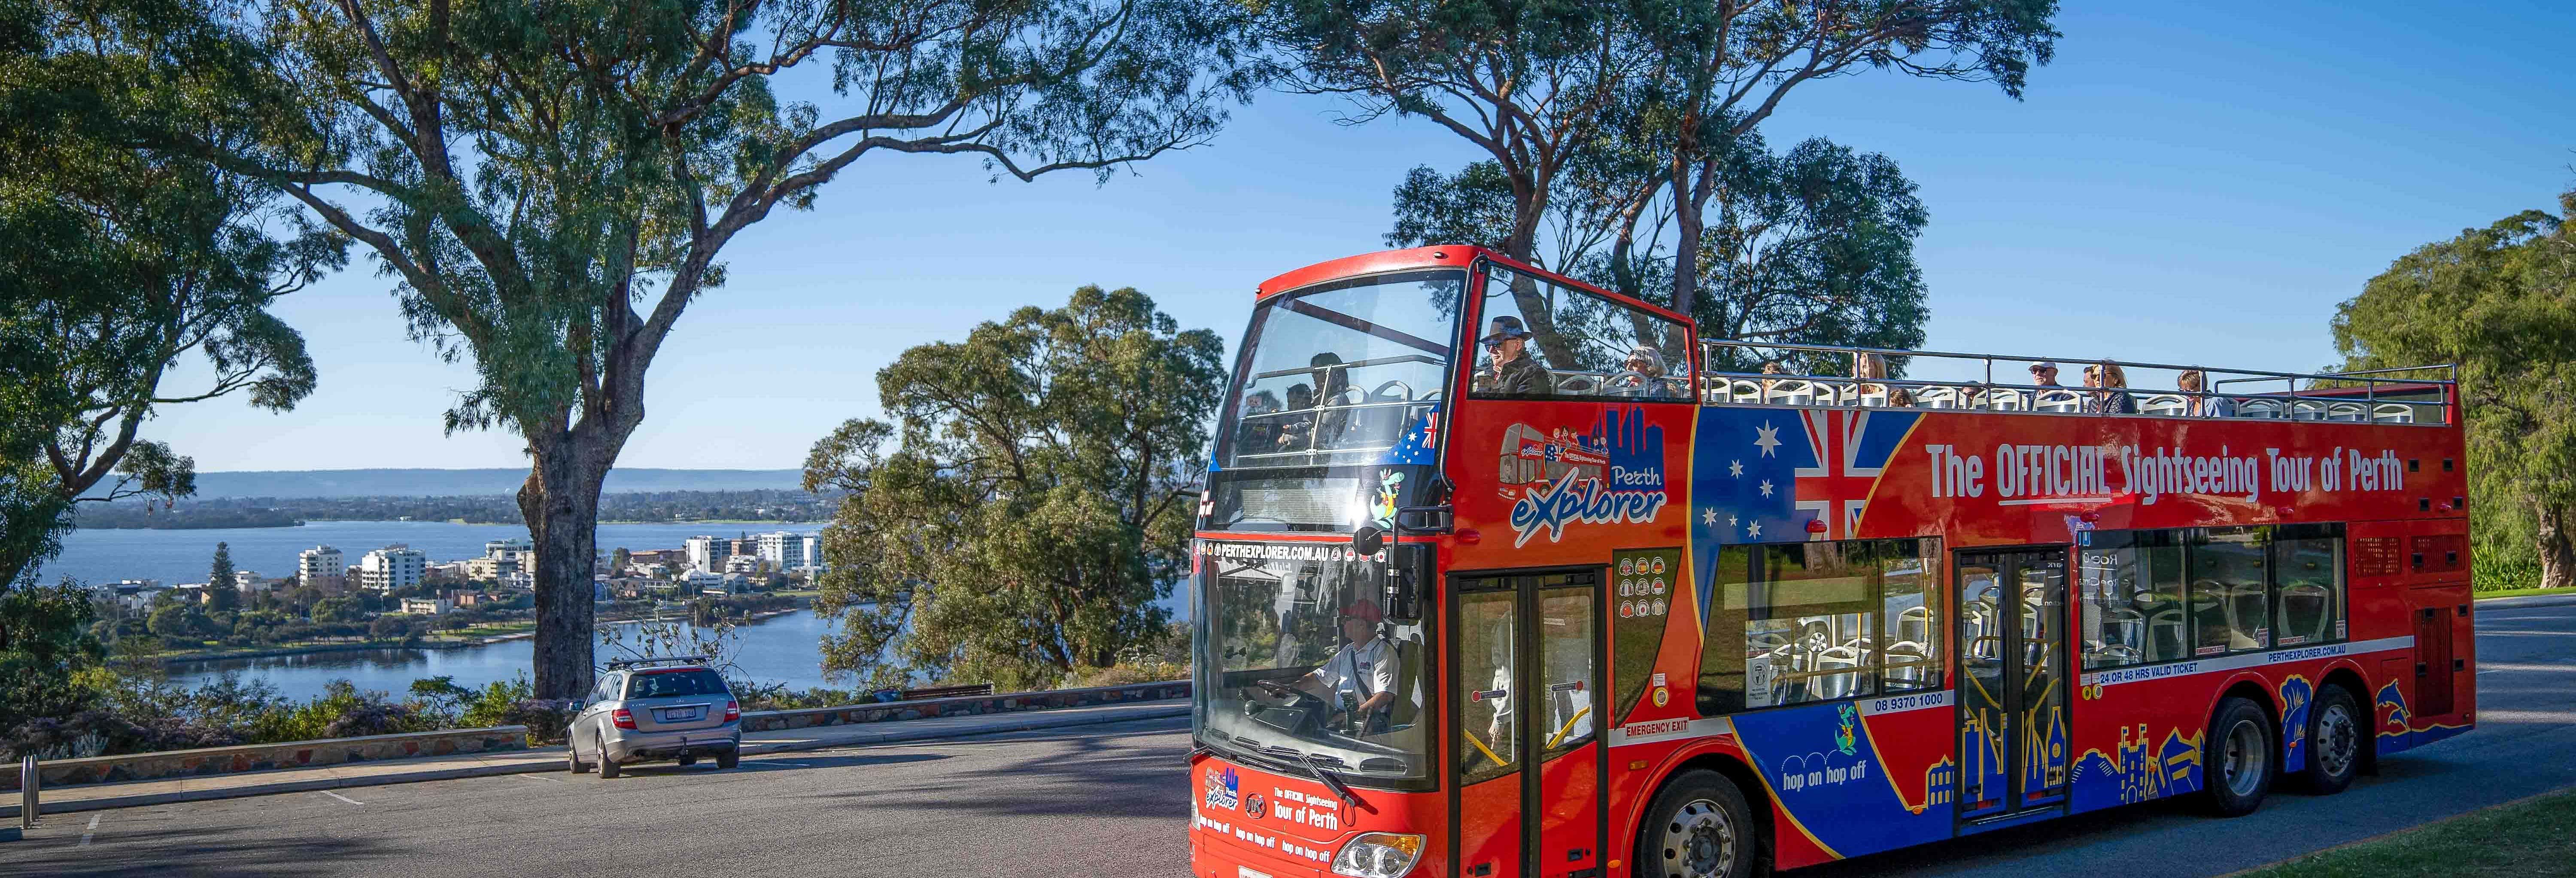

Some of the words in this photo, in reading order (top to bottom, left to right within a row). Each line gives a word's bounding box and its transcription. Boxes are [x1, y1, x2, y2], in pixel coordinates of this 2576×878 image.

[1611, 465, 1662, 486] Perth
[1926, 444, 1983, 498] The
[1996, 444, 2111, 497] OFFICIAL
[2121, 444, 2258, 505] Sightseeing
[2266, 447, 2313, 492] Tour
[2321, 447, 2341, 492] of
[2349, 447, 2403, 491] Perth
[1221, 544, 1329, 561] PERTHEXPLORER.COM.AU
[2269, 645, 2346, 662] PERTHEXPLORER.COM.AU
[2100, 674, 2109, 684] 24
[2111, 671, 2122, 682] OR
[2124, 670, 2133, 680] 48
[2135, 668, 2150, 679] HRS
[2151, 665, 2171, 677] VALID
[2173, 662, 2198, 674] TICKET
[1875, 700, 1887, 711] 08
[1891, 696, 1915, 709] 9370
[1919, 693, 1943, 706] 1000
[1627, 721, 1671, 737] EMERGENCY
[1672, 720, 1688, 732] EXIT
[1783, 773, 1804, 792] hop
[1808, 771, 1822, 786] on
[1826, 766, 1847, 785] hop
[1850, 760, 1866, 780] off
[1274, 787, 1283, 798] The
[1284, 789, 1304, 802] OFFICIAL
[1306, 793, 1338, 811] Sightseeing
[1213, 819, 1222, 833] hop
[1273, 800, 1293, 820] Tour
[1295, 806, 1306, 823] of
[1309, 808, 1338, 831] Perth
[1236, 826, 1245, 841] hop
[1246, 832, 1254, 842] on
[1255, 832, 1265, 848] hop
[1266, 836, 1276, 848] off
[1282, 839, 1294, 856] hop
[1295, 845, 1303, 856] on
[1305, 846, 1317, 862] hop
[1319, 851, 1331, 863] off
